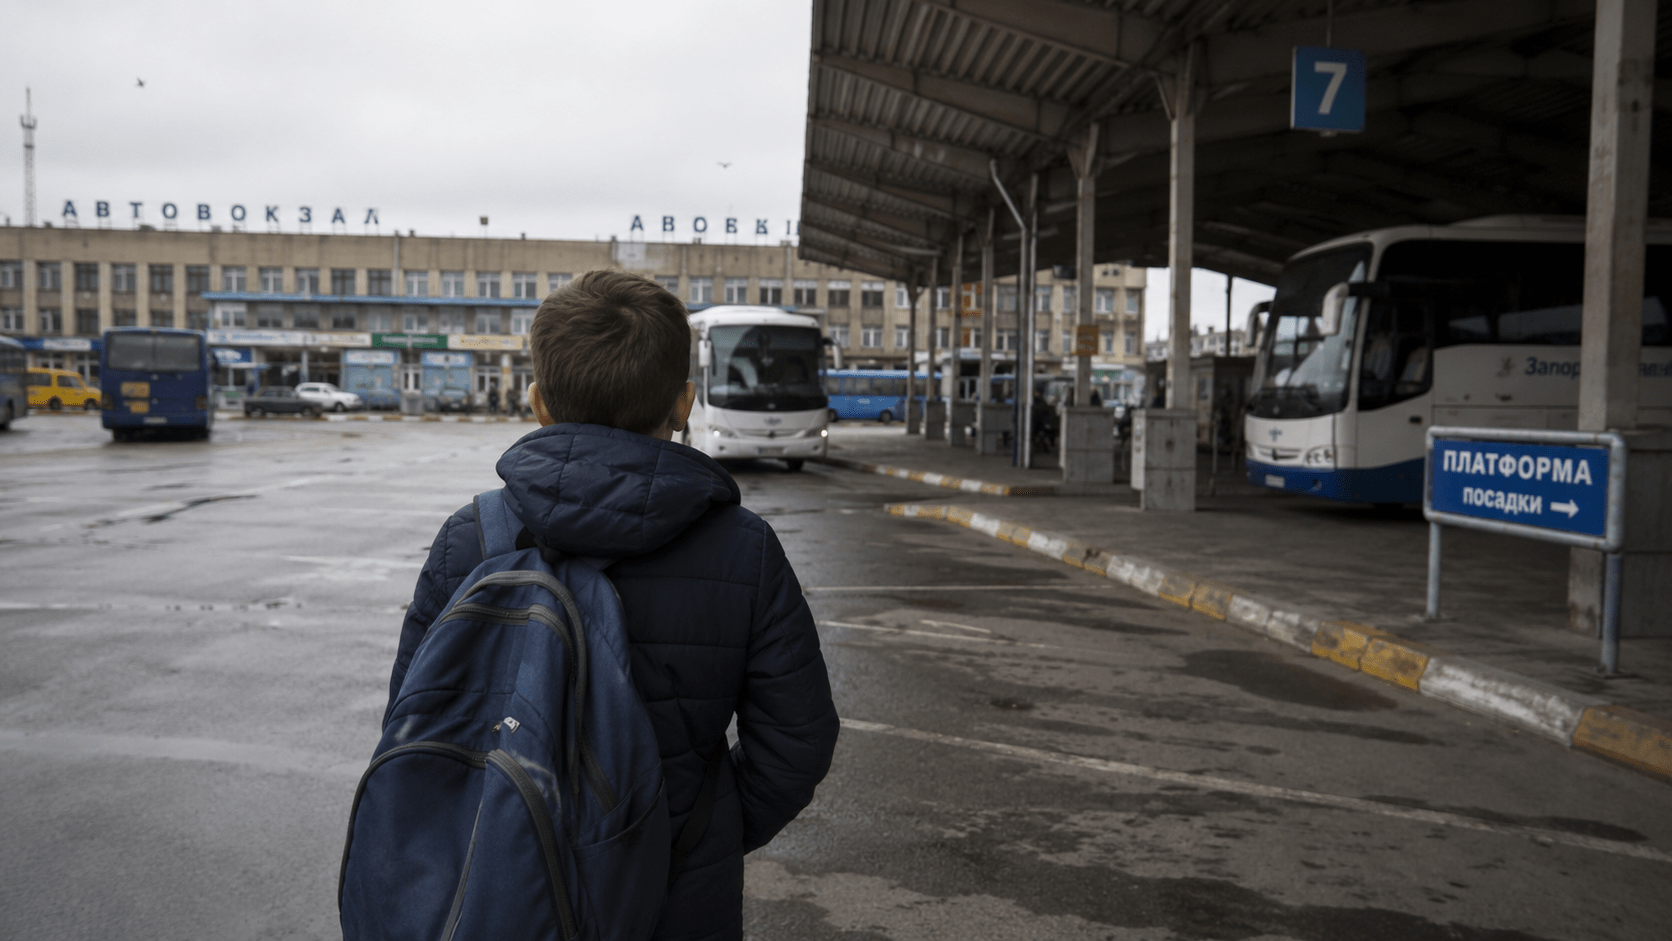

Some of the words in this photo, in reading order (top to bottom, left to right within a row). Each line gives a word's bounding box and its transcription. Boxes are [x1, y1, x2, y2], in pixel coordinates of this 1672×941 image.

[1314, 61, 1347, 115] 7
[62, 200, 379, 224] АВТОВОКЗАЛ
[1443, 449, 1593, 486] ПЛАТФОРМА
[1463, 486, 1542, 515] посадки
